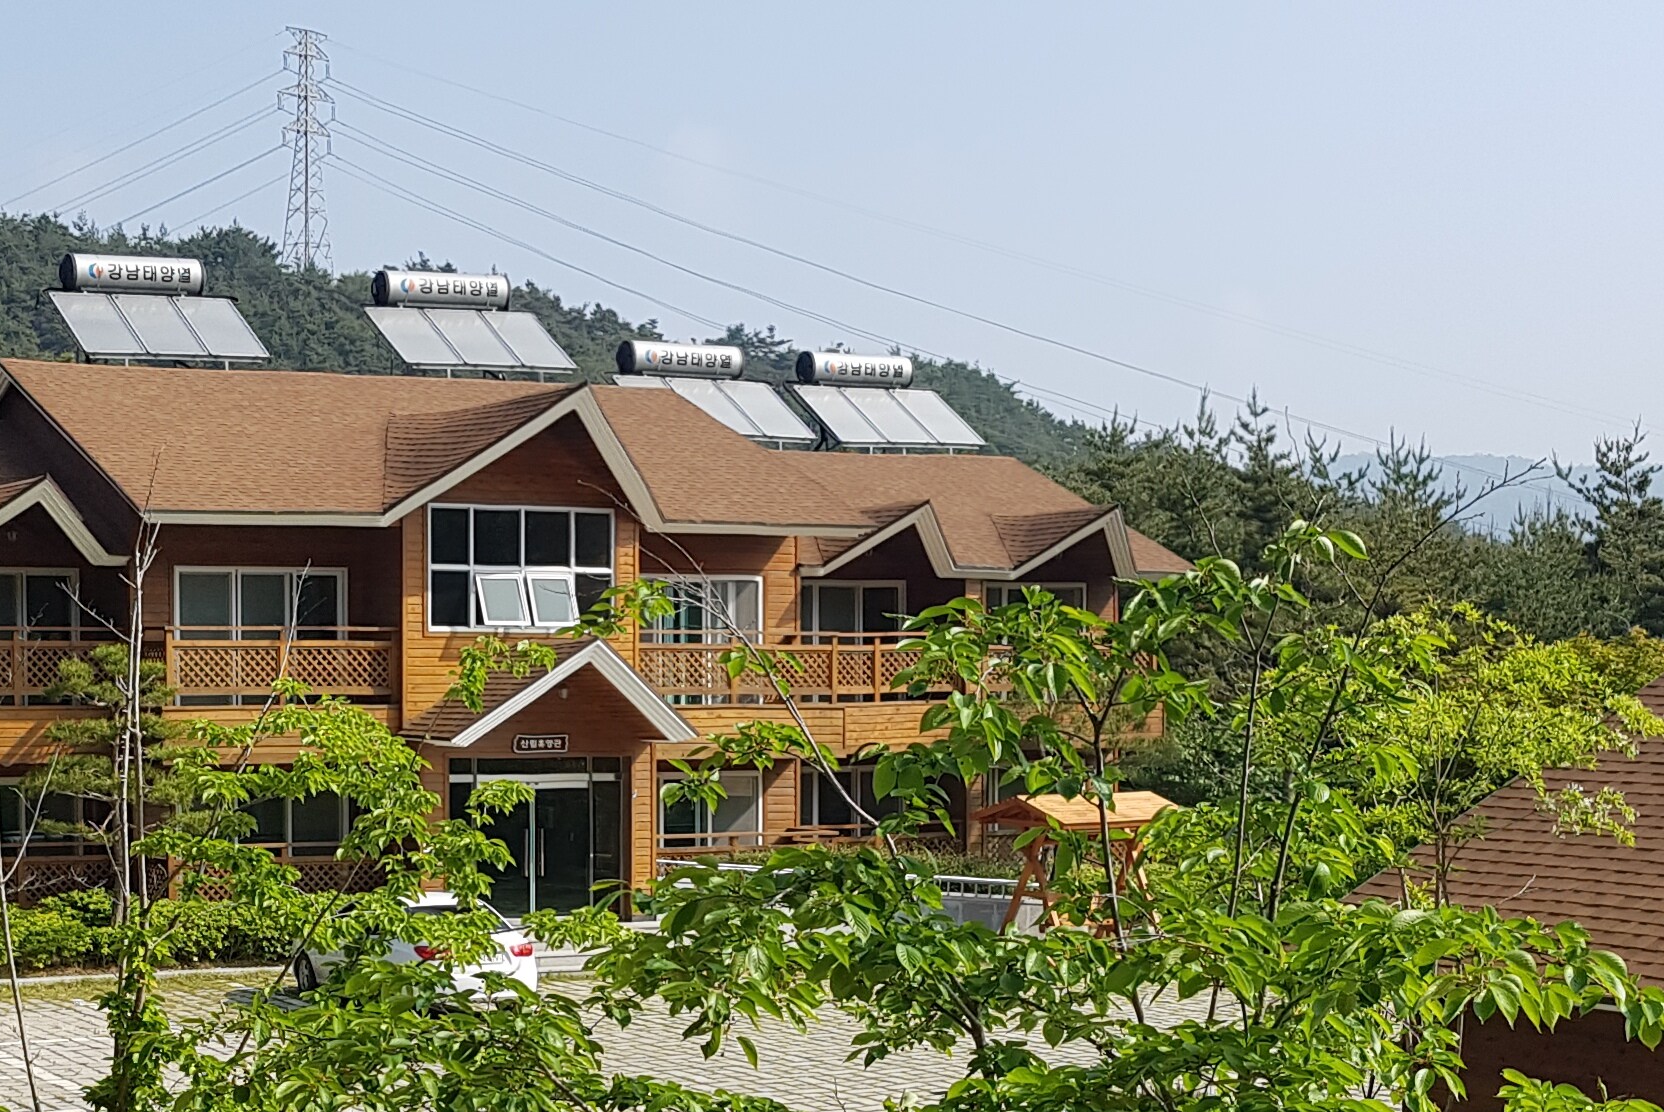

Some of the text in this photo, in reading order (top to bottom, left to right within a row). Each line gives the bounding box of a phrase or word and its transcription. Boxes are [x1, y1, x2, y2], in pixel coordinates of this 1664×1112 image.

[107, 263, 191, 284] 강남태양열
[419, 278, 498, 298] 강남태양열
[660, 350, 732, 369] 강남태양열
[837, 362, 904, 379] 강남태양열
